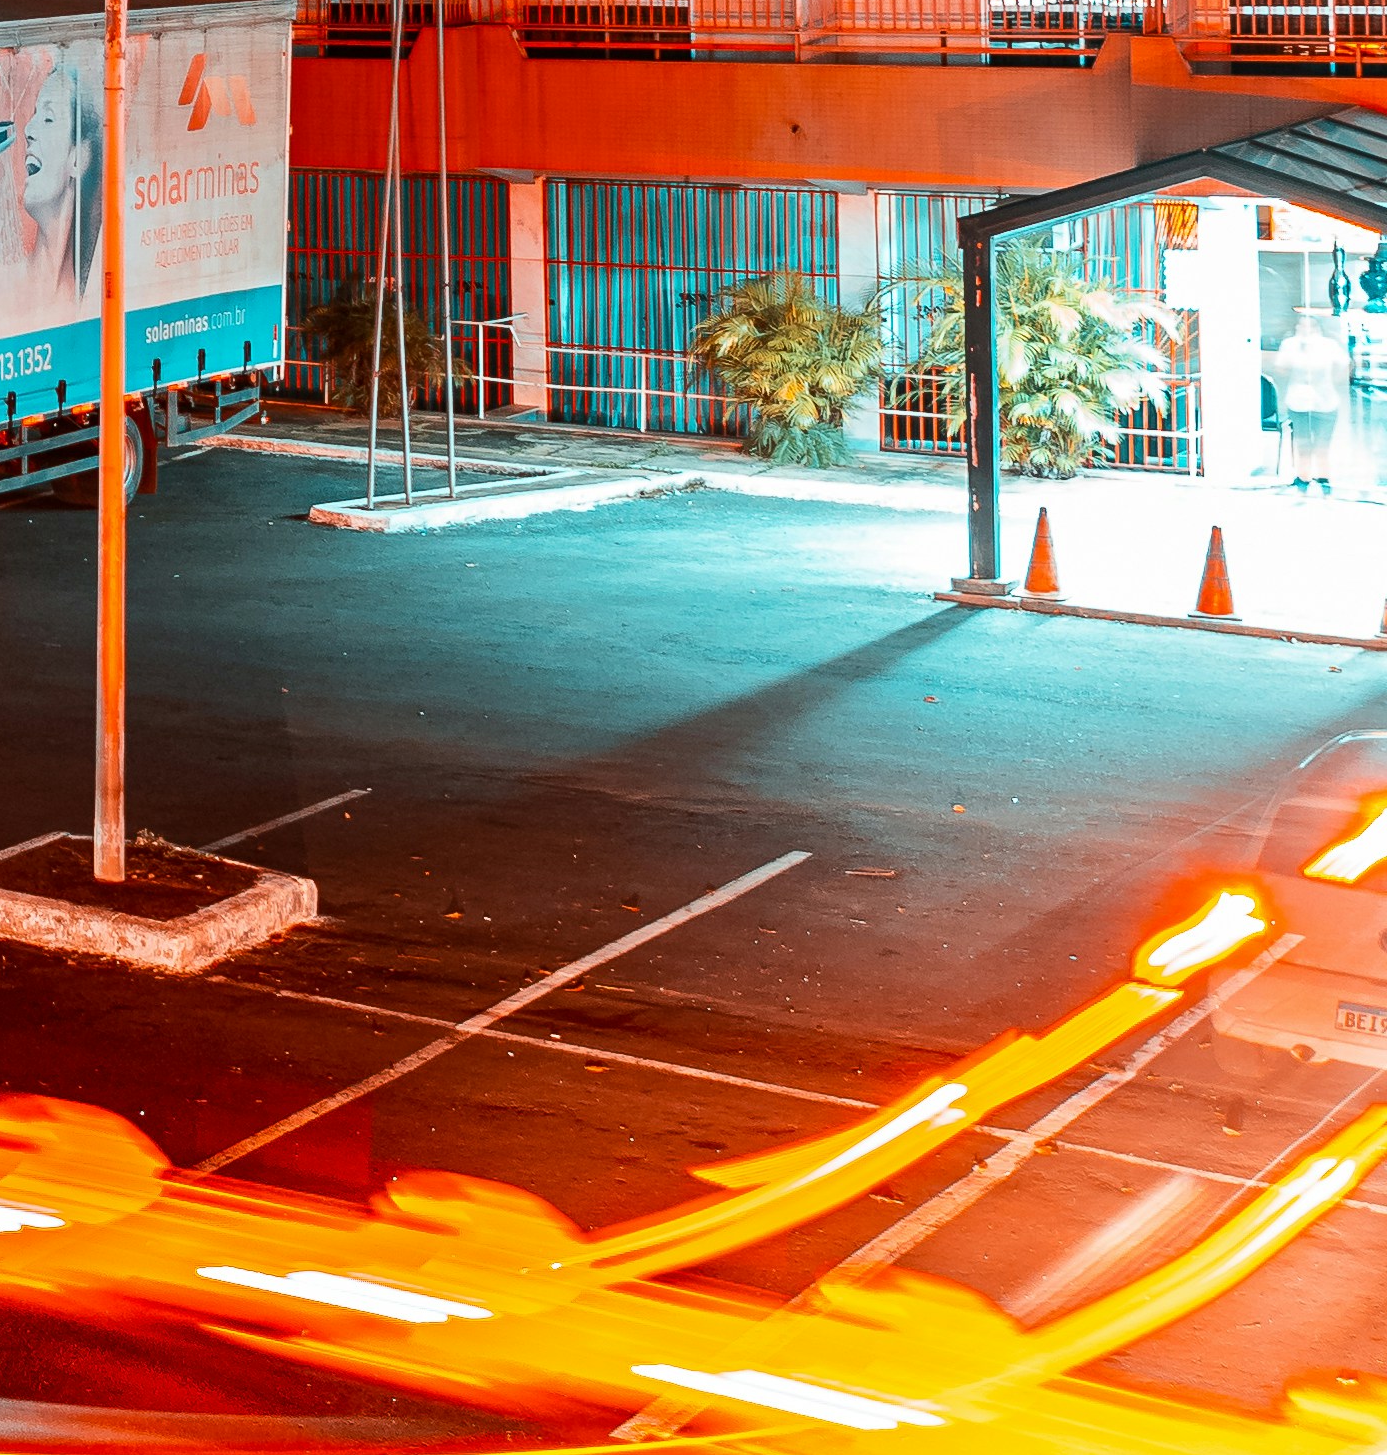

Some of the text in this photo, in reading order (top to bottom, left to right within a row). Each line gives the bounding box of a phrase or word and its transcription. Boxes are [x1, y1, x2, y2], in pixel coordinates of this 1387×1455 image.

[134, 153, 260, 210] solarminas
[153, 221, 198, 244] MELHORES
[240, 214, 253, 231] EM
[214, 237, 240, 257] SOLAR
[145, 305, 246, 344] solarminas.com.br
